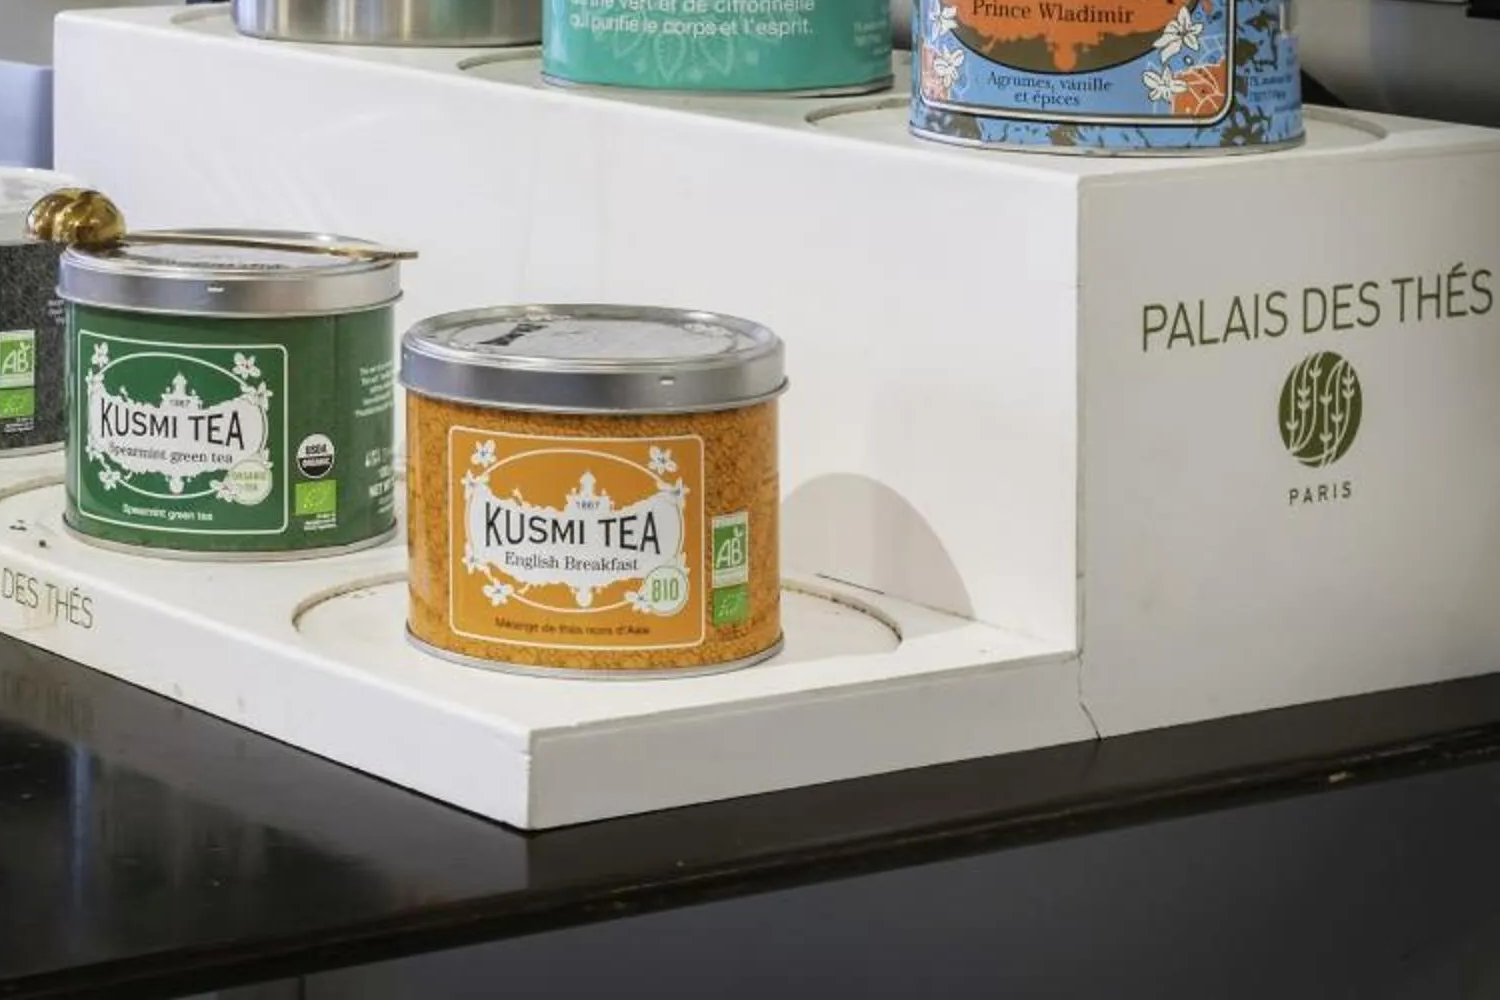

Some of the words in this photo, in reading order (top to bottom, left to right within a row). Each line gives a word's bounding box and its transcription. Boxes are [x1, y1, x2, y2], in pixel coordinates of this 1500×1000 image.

[972, 0, 1031, 20] Prince
[1039, 0, 1135, 24] Wladimir
[644, 17, 657, 32] le
[663, 20, 716, 37] corps
[719, 19, 738, 35] et
[1060, 76, 1114, 93] vanille
[1014, 91, 1028, 104] et
[1032, 90, 1080, 107] épices
[1143, 291, 1288, 352] PALAIS
[1303, 281, 1380, 333] DES
[1391, 261, 1493, 323] THÉS
[100, 398, 177, 438] KUSMI
[188, 411, 244, 450] TEA
[170, 452, 208, 464] green
[212, 452, 233, 463] tea
[1289, 481, 1352, 505] PARIS
[168, 510, 195, 521] green
[485, 502, 585, 547] KUSMI
[598, 511, 660, 554] TEA
[505, 551, 559, 570] English
[564, 553, 639, 571] Breakfast
[3, 567, 39, 609] DES
[45, 584, 93, 629] THÉS
[652, 576, 680, 602] BIO
